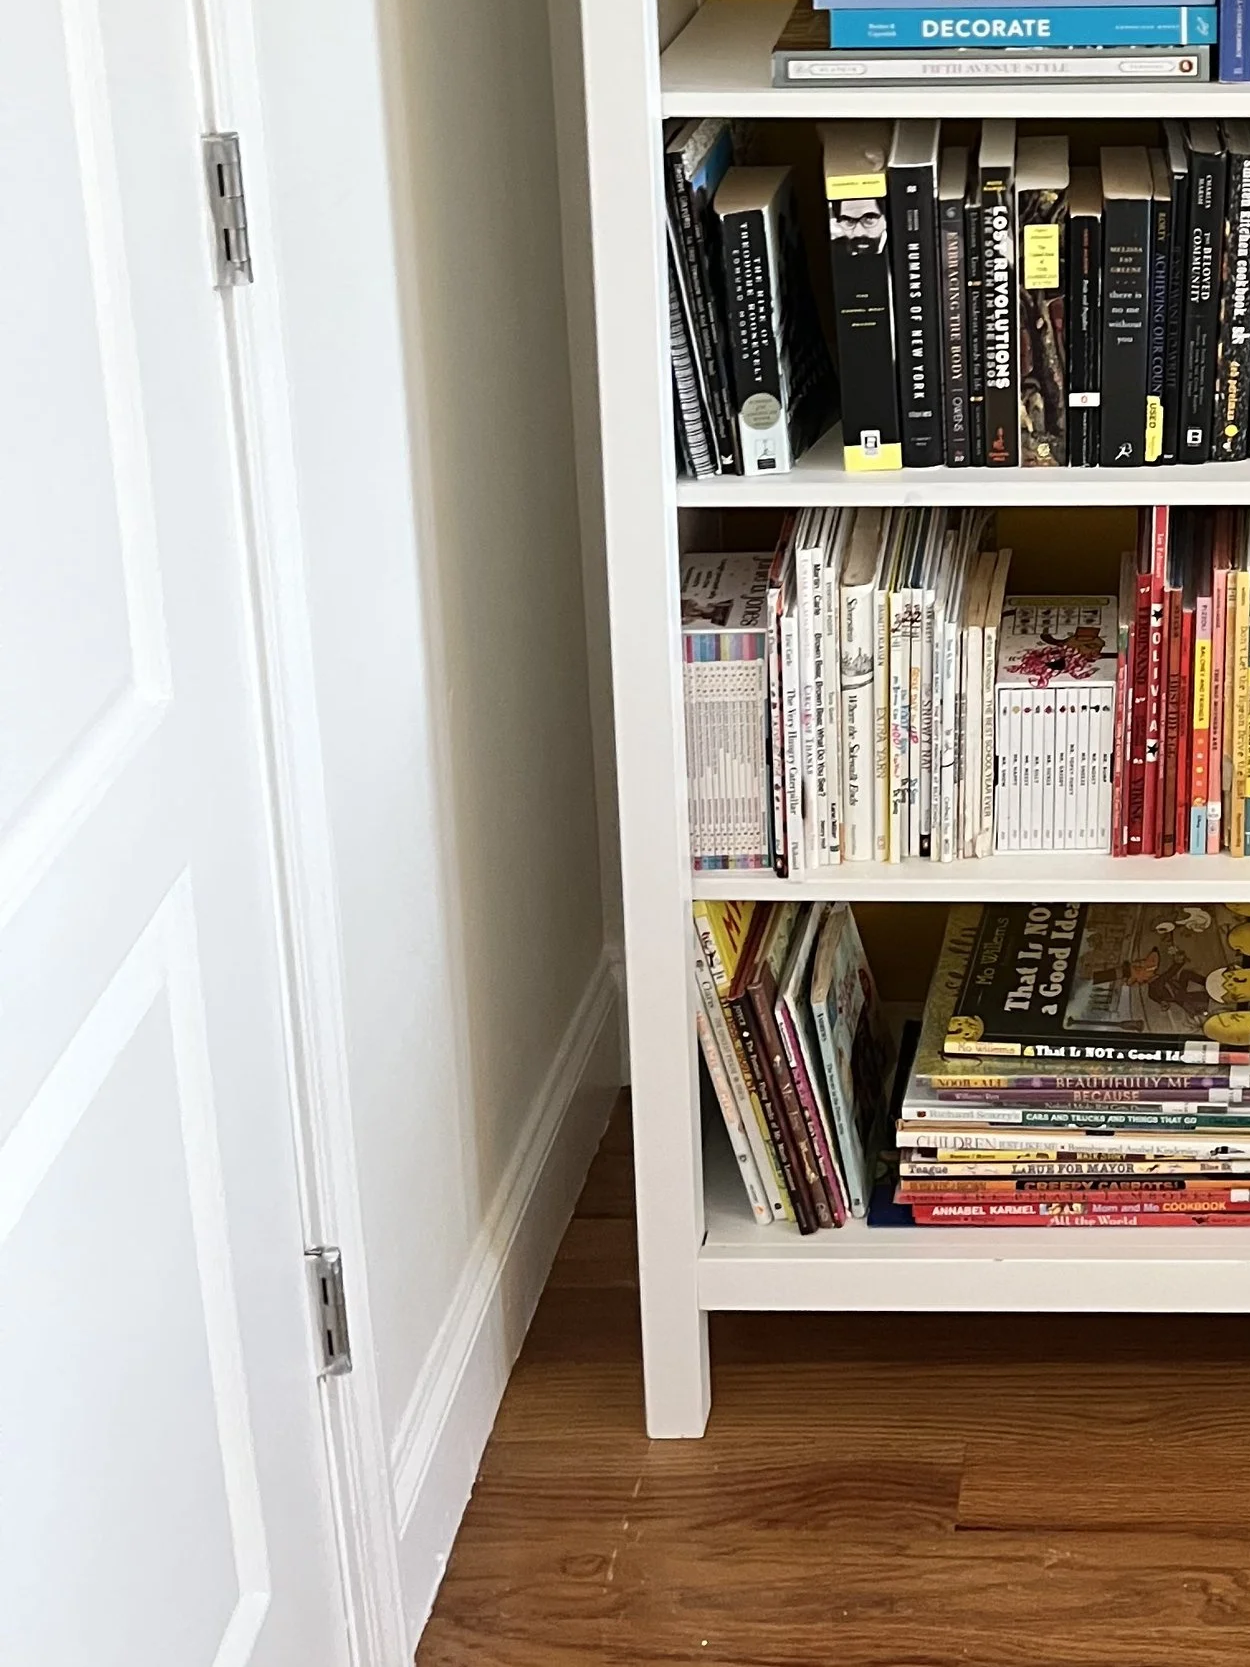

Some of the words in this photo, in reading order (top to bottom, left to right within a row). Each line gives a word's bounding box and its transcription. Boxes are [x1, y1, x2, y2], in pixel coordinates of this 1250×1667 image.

[922, 19, 1051, 37] DECORATE
[992, 206, 1007, 250] LOST
[907, 243, 922, 299] HUMANS
[909, 305, 921, 322] OF
[993, 255, 1010, 389] REVOLUTIONS
[911, 330, 923, 357] NEW
[912, 365, 925, 400] YORK
[1148, 403, 1157, 429] USED
[1149, 631, 1161, 732] OLIVIA
[1039, 947, 1071, 997] Good
[1004, 967, 1038, 1011] That
[1041, 1004, 1058, 1015] a
[1035, 1045, 1065, 1056] That
[1085, 1047, 1114, 1059] NOT
[1117, 1051, 1124, 1060] a
[1129, 1048, 1161, 1061] Good
[1168, 1079, 1190, 1089] ME
[1074, 1091, 1139, 1101] BECAUSE
[1026, 1113, 1048, 1122] CARS
[1051, 1114, 1070, 1122] AND
[1107, 1115, 1124, 1123] AND
[1127, 1115, 1156, 1124] THINGS
[1159, 1116, 1182, 1124] THAT
[1059, 1164, 1084, 1173] FOR
[1087, 1163, 1134, 1173] MAYOR
[932, 1207, 985, 1216] ANNABEL
[990, 1205, 1035, 1215] KARMEL
[1093, 1204, 1117, 1213] Mom
[1120, 1205, 1139, 1213] and
[1143, 1205, 1160, 1213] Me
[1163, 1202, 1226, 1212] COOKBOOK
[1051, 1215, 1070, 1226] All
[1073, 1216, 1095, 1226] the
[1099, 1216, 1137, 1226] World
